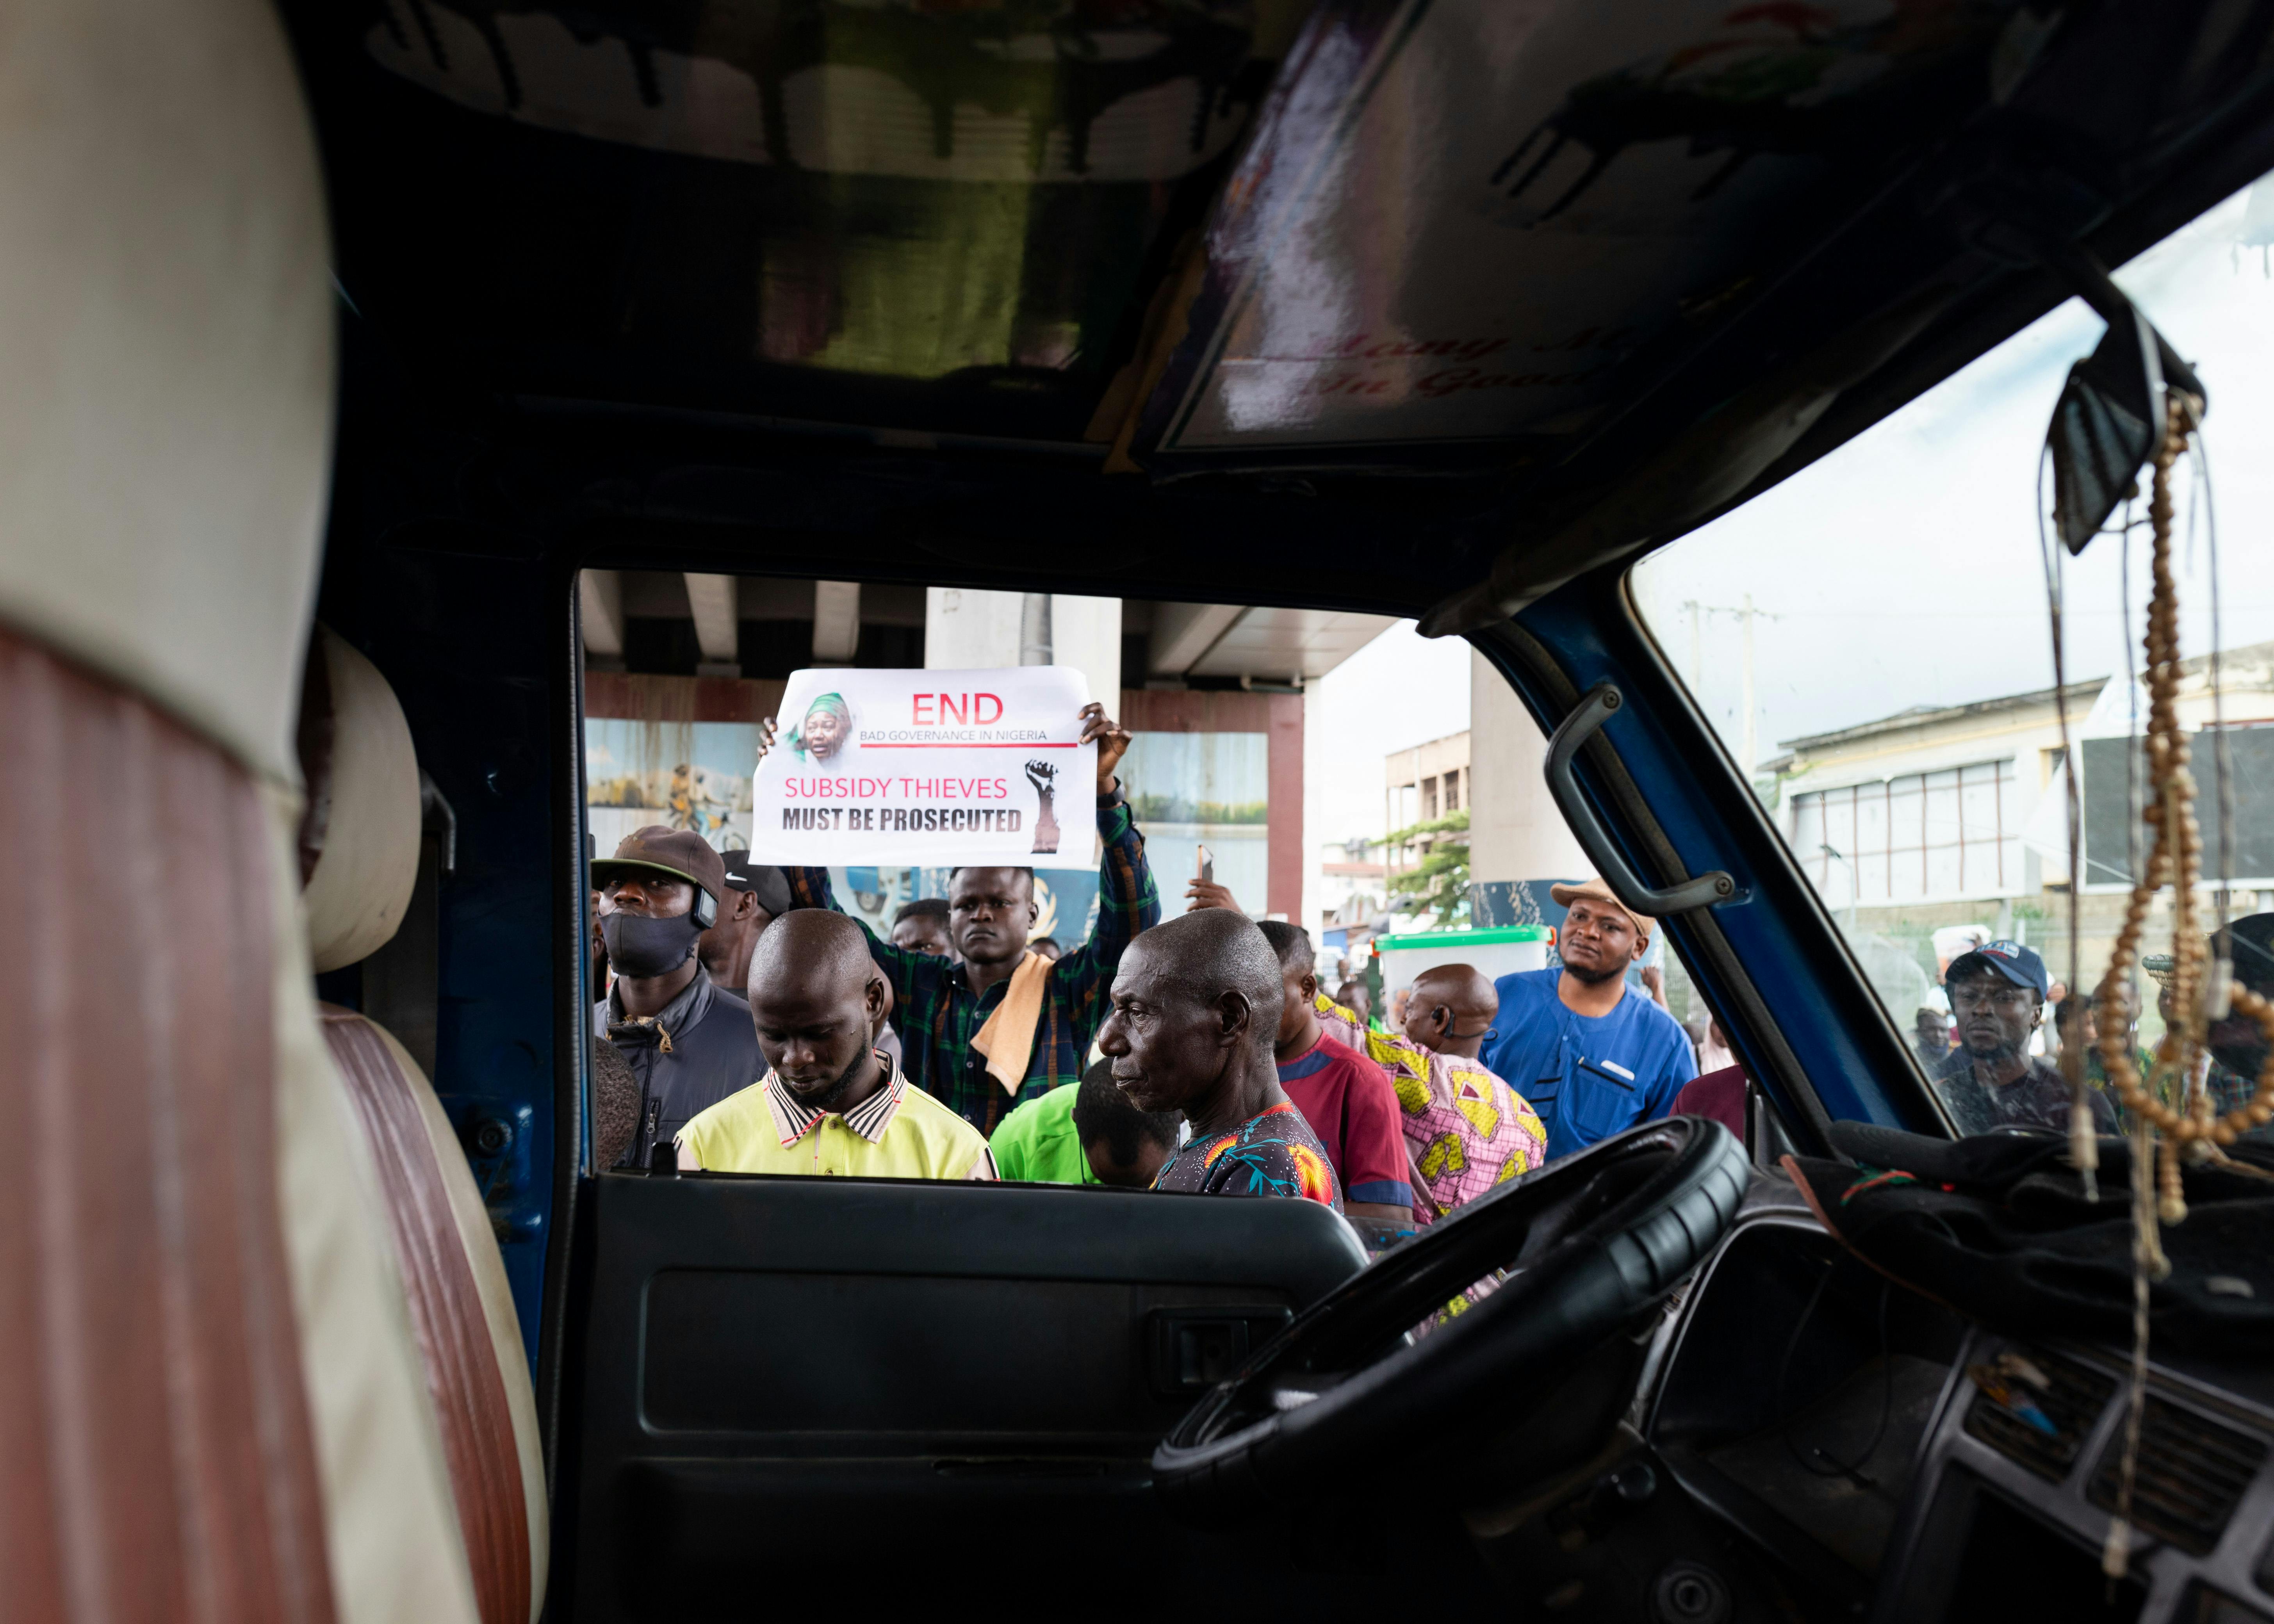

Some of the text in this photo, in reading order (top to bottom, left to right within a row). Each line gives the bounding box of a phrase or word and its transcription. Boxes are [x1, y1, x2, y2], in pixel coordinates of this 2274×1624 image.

[912, 693, 1003, 725] END
[860, 730, 1047, 741] BAD GOVERNANCE IN NIGERIA
[785, 778, 1007, 799] SUBSIDY THIEVES
[782, 808, 1022, 832] MUST BE PROSECUTED
